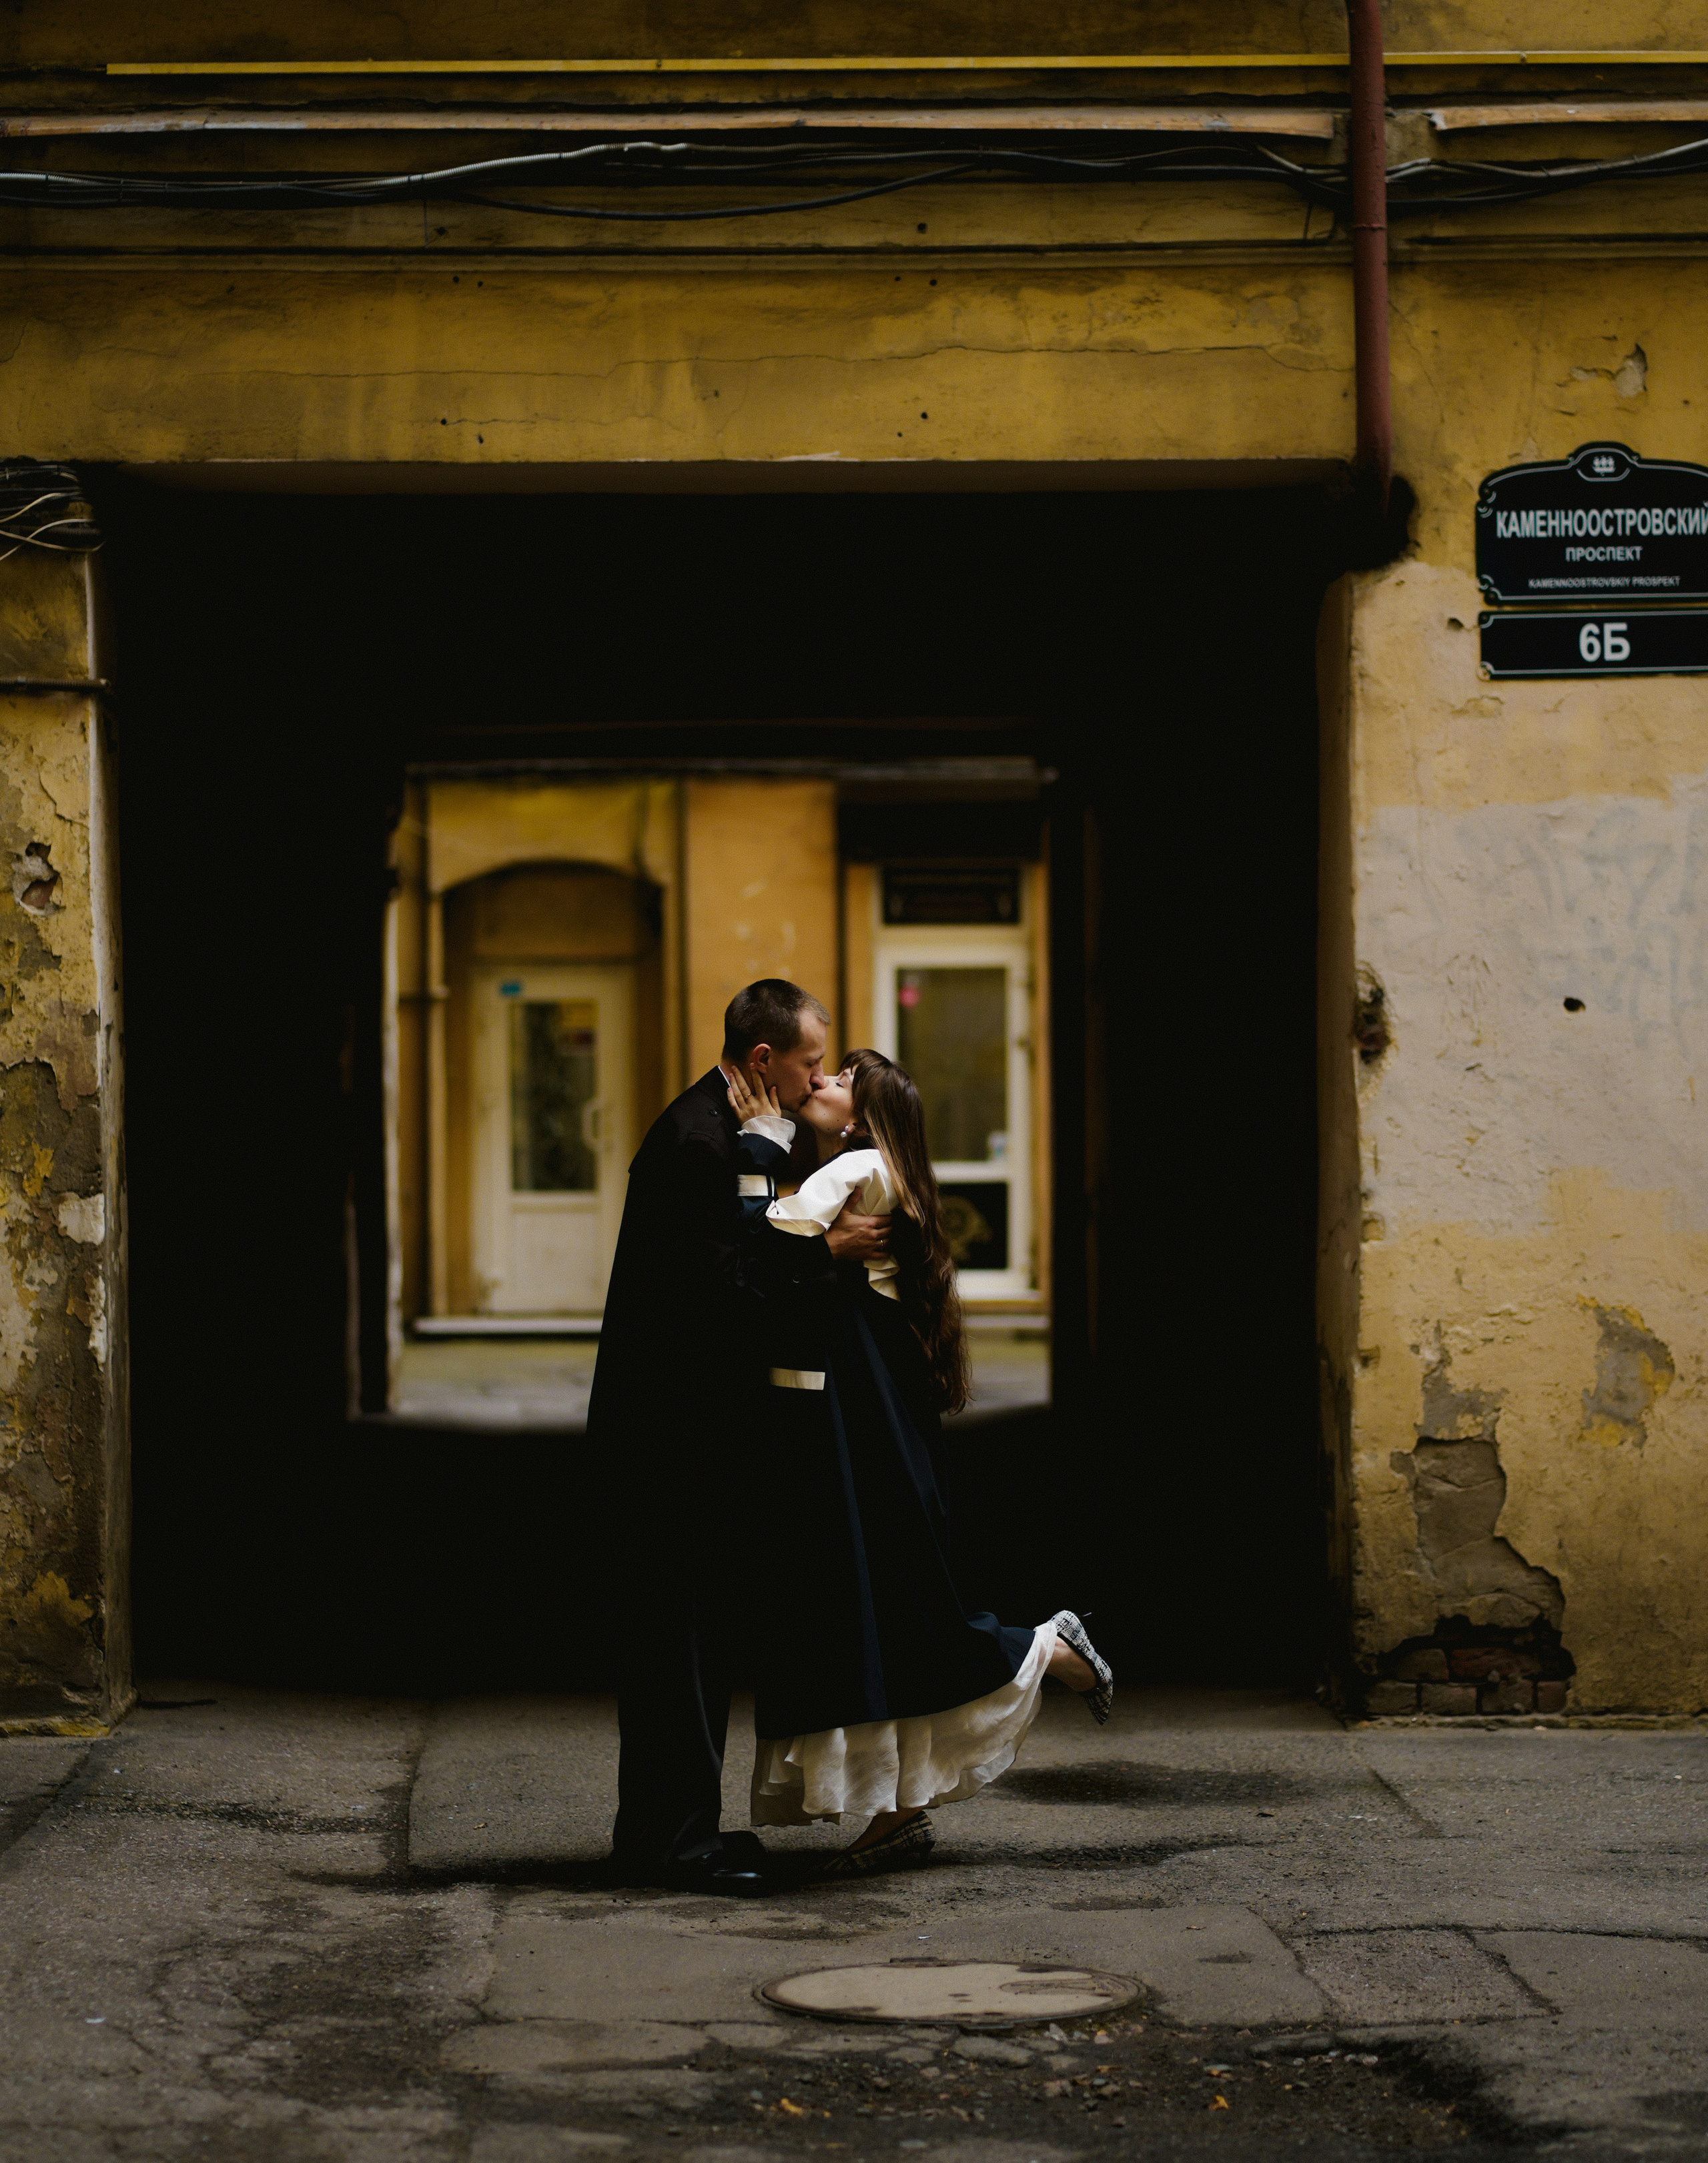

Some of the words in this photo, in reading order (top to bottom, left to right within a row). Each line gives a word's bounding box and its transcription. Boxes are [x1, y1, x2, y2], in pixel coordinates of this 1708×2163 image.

[1566, 546, 1642, 561] ПРОСПЕКТ
[1529, 577, 1629, 588] KAMENNOOSTROVSKIY
[1632, 576, 1681, 586] PROSPEKT
[1579, 622, 1631, 662] 6Б
